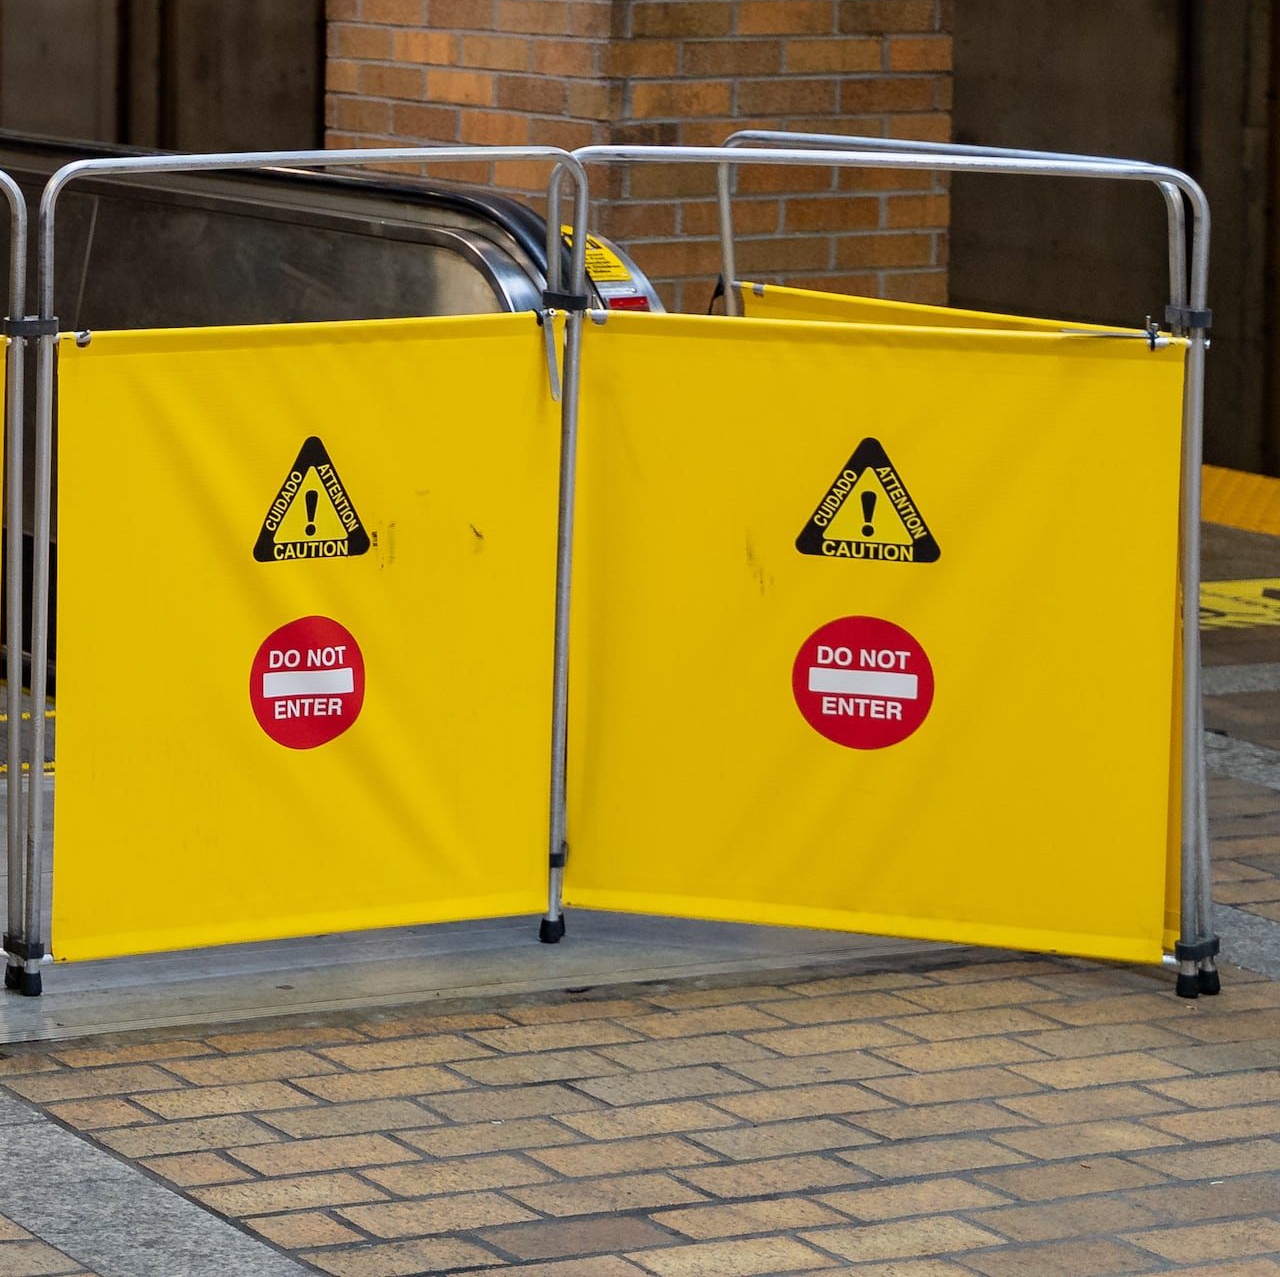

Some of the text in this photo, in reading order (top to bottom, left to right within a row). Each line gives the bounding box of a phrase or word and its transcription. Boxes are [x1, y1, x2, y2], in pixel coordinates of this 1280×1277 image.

[265, 470, 302, 533] CUIDADO
[317, 463, 360, 532] ATTENTION
[813, 469, 857, 527] CUIDADO
[876, 466, 927, 539] ATTENTION
[273, 540, 349, 560] CAUTION
[822, 540, 914, 562] CAUTION
[269, 646, 346, 668] DO NOT
[817, 645, 911, 669] DO NOT
[274, 698, 342, 719] ENTER
[822, 696, 903, 720] ENTER
